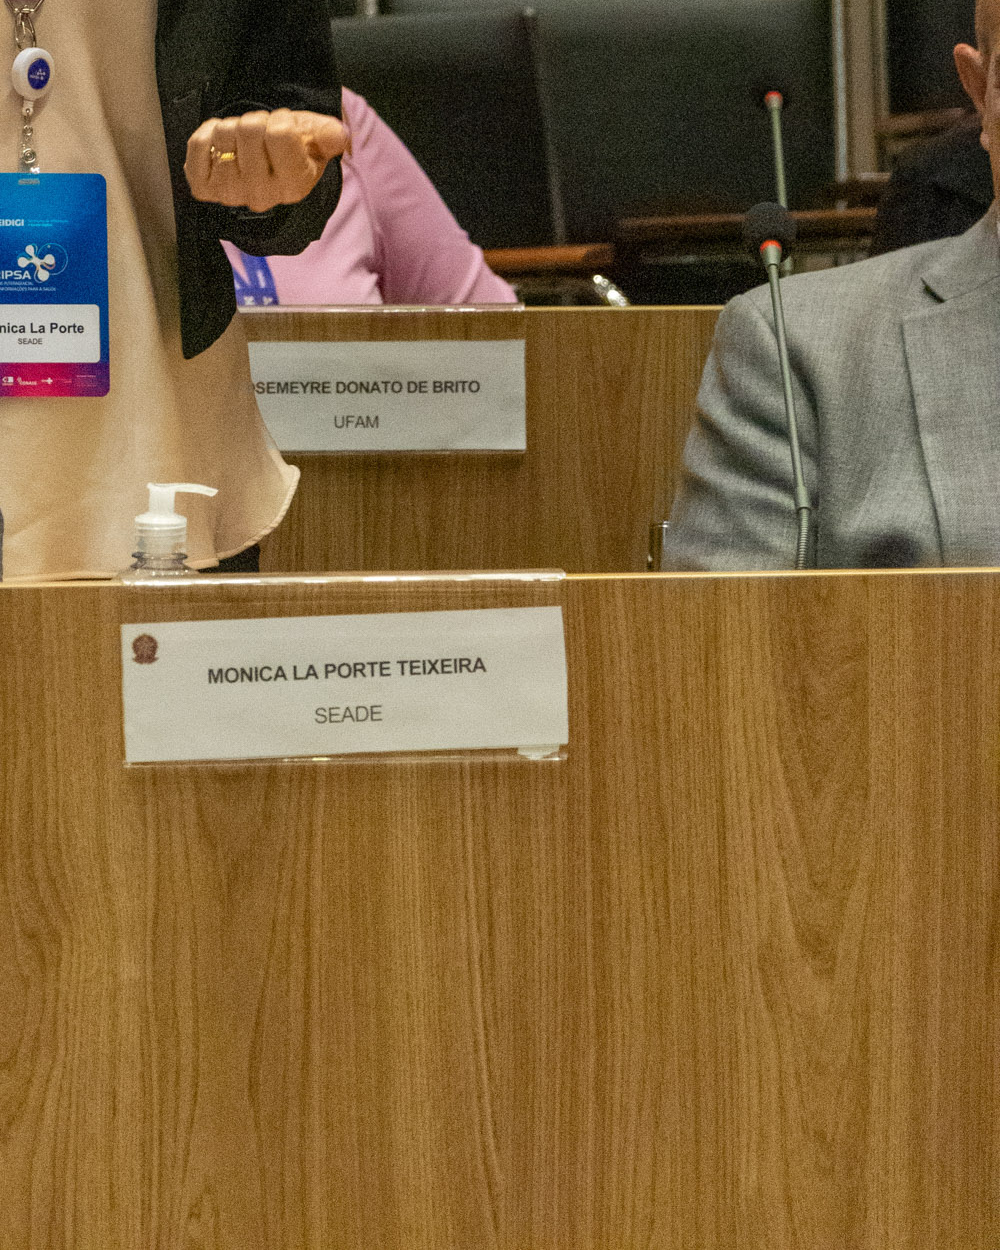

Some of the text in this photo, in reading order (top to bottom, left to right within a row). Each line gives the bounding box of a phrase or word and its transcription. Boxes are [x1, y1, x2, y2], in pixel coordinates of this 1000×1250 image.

[30, 322, 46, 334] La
[50, 322, 85, 334] Porte
[253, 380, 481, 394] SEMEYRE DONATO DE BRITO
[334, 415, 380, 429] UFAM
[207, 657, 487, 684] MONICA LA PORTE TEIXEIRA
[314, 705, 383, 724] SEADE
